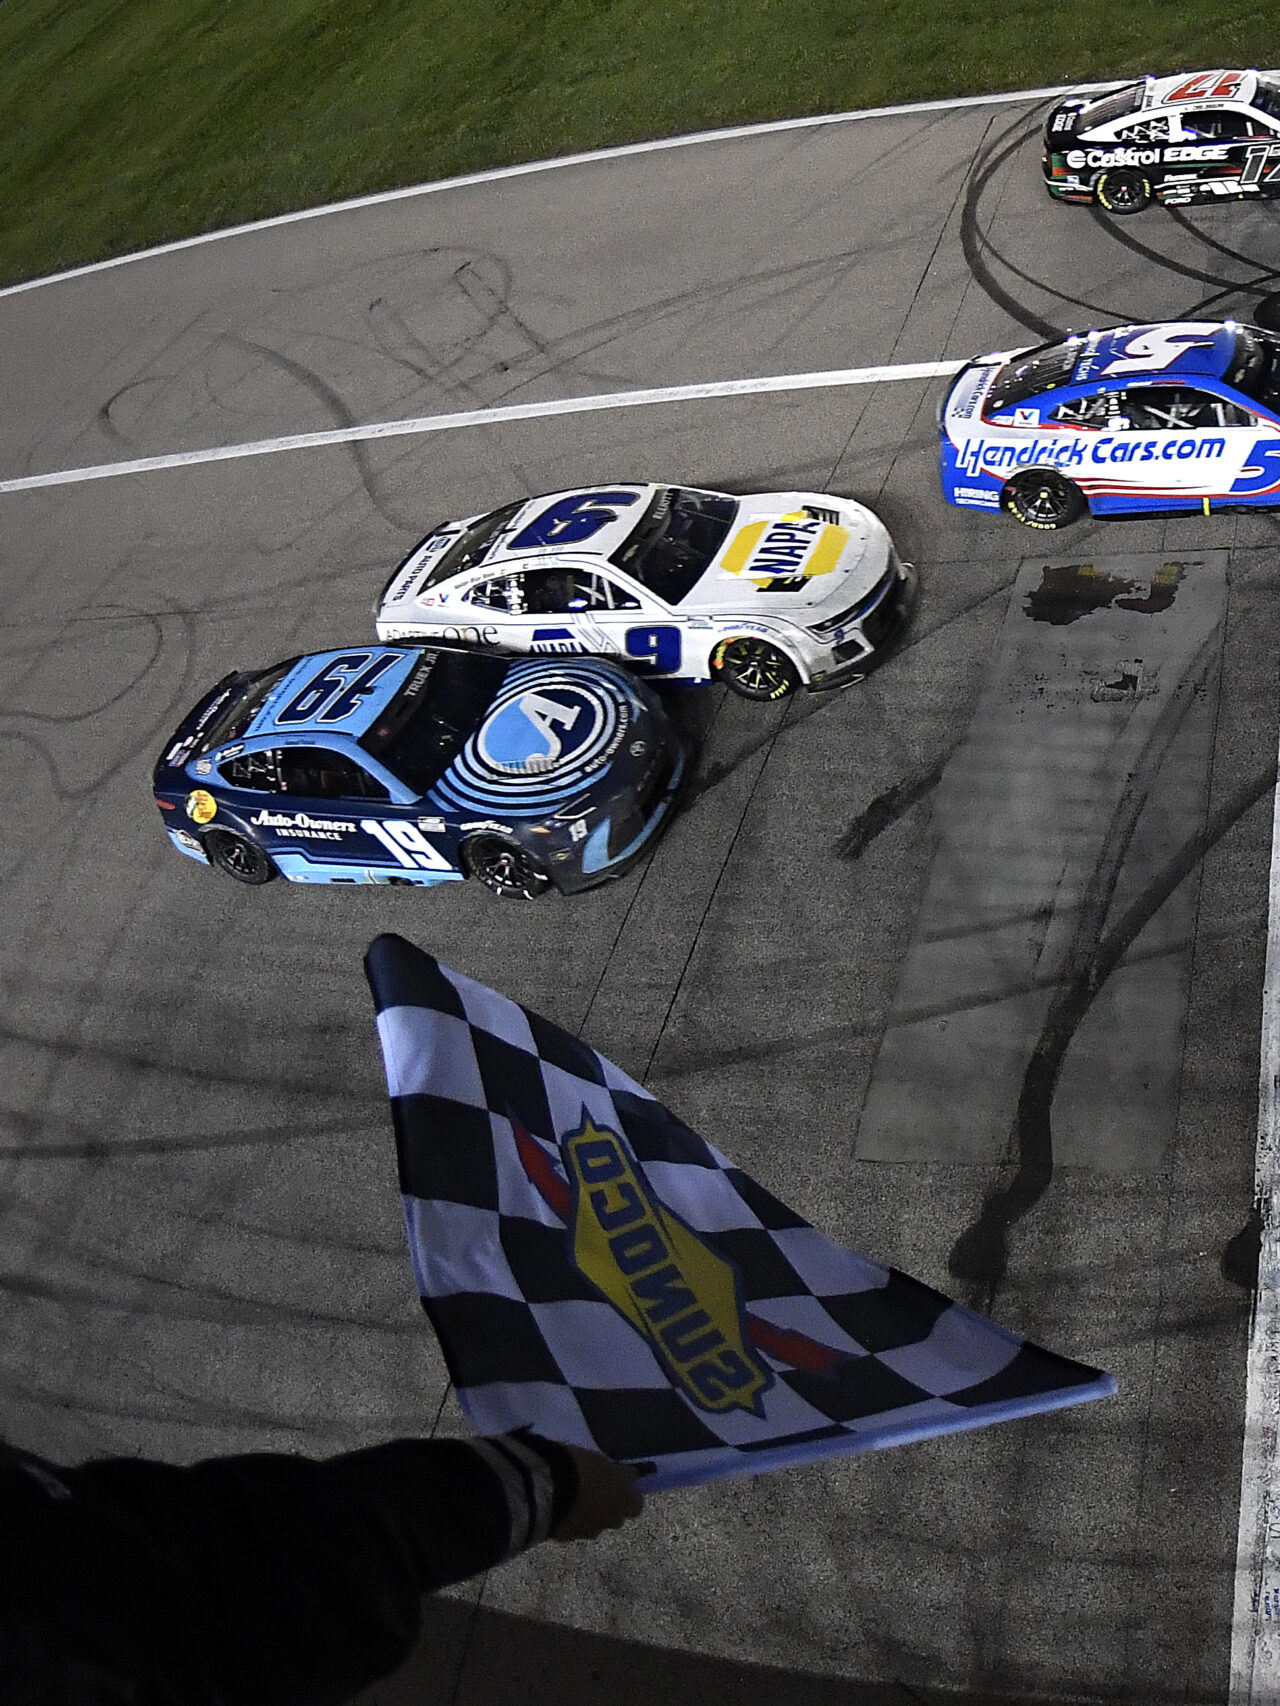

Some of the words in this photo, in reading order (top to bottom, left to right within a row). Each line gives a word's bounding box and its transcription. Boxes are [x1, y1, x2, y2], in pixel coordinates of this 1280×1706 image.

[1161, 73, 1244, 104] 17
[1087, 148, 1161, 168] Castrol
[1163, 145, 1229, 162] EDGE
[506, 491, 641, 550] 9
[748, 522, 821, 573] NAPA
[625, 625, 682, 677] 9
[274, 653, 406, 725] 19
[404, 663, 433, 698] TRUEX
[584, 704, 628, 773] auto-owners.com
[250, 809, 358, 833] Auto-Owners
[275, 828, 343, 841] INSURANCE
[360, 819, 454, 871] 19
